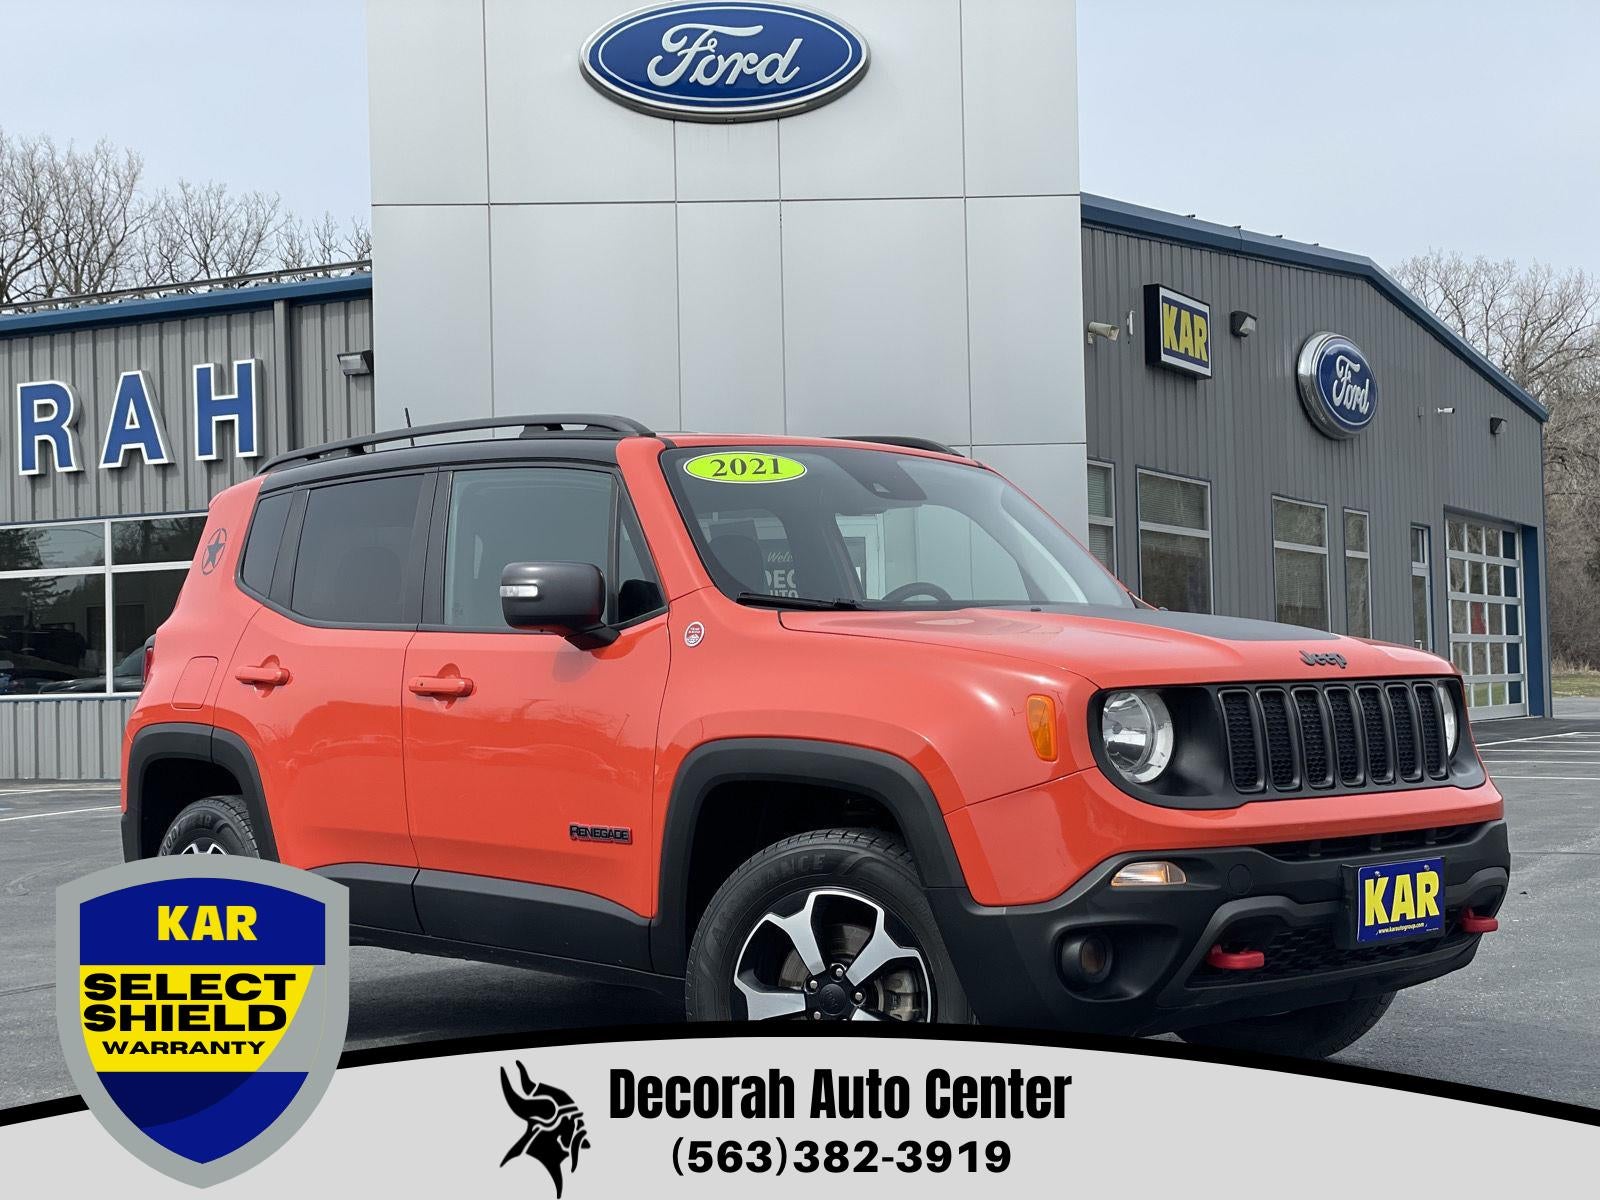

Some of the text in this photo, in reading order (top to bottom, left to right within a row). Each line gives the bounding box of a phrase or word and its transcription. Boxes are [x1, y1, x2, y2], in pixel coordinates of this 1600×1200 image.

[647, 23, 803, 87] Ford
[1162, 303, 1209, 362] KAR
[1333, 355, 1370, 415] Ford
[17, 358, 260, 475] RAH
[710, 457, 783, 477] 2021
[1299, 649, 1347, 669] Jeep
[569, 823, 632, 843] RENEGADE
[1364, 871, 1440, 927] KAR
